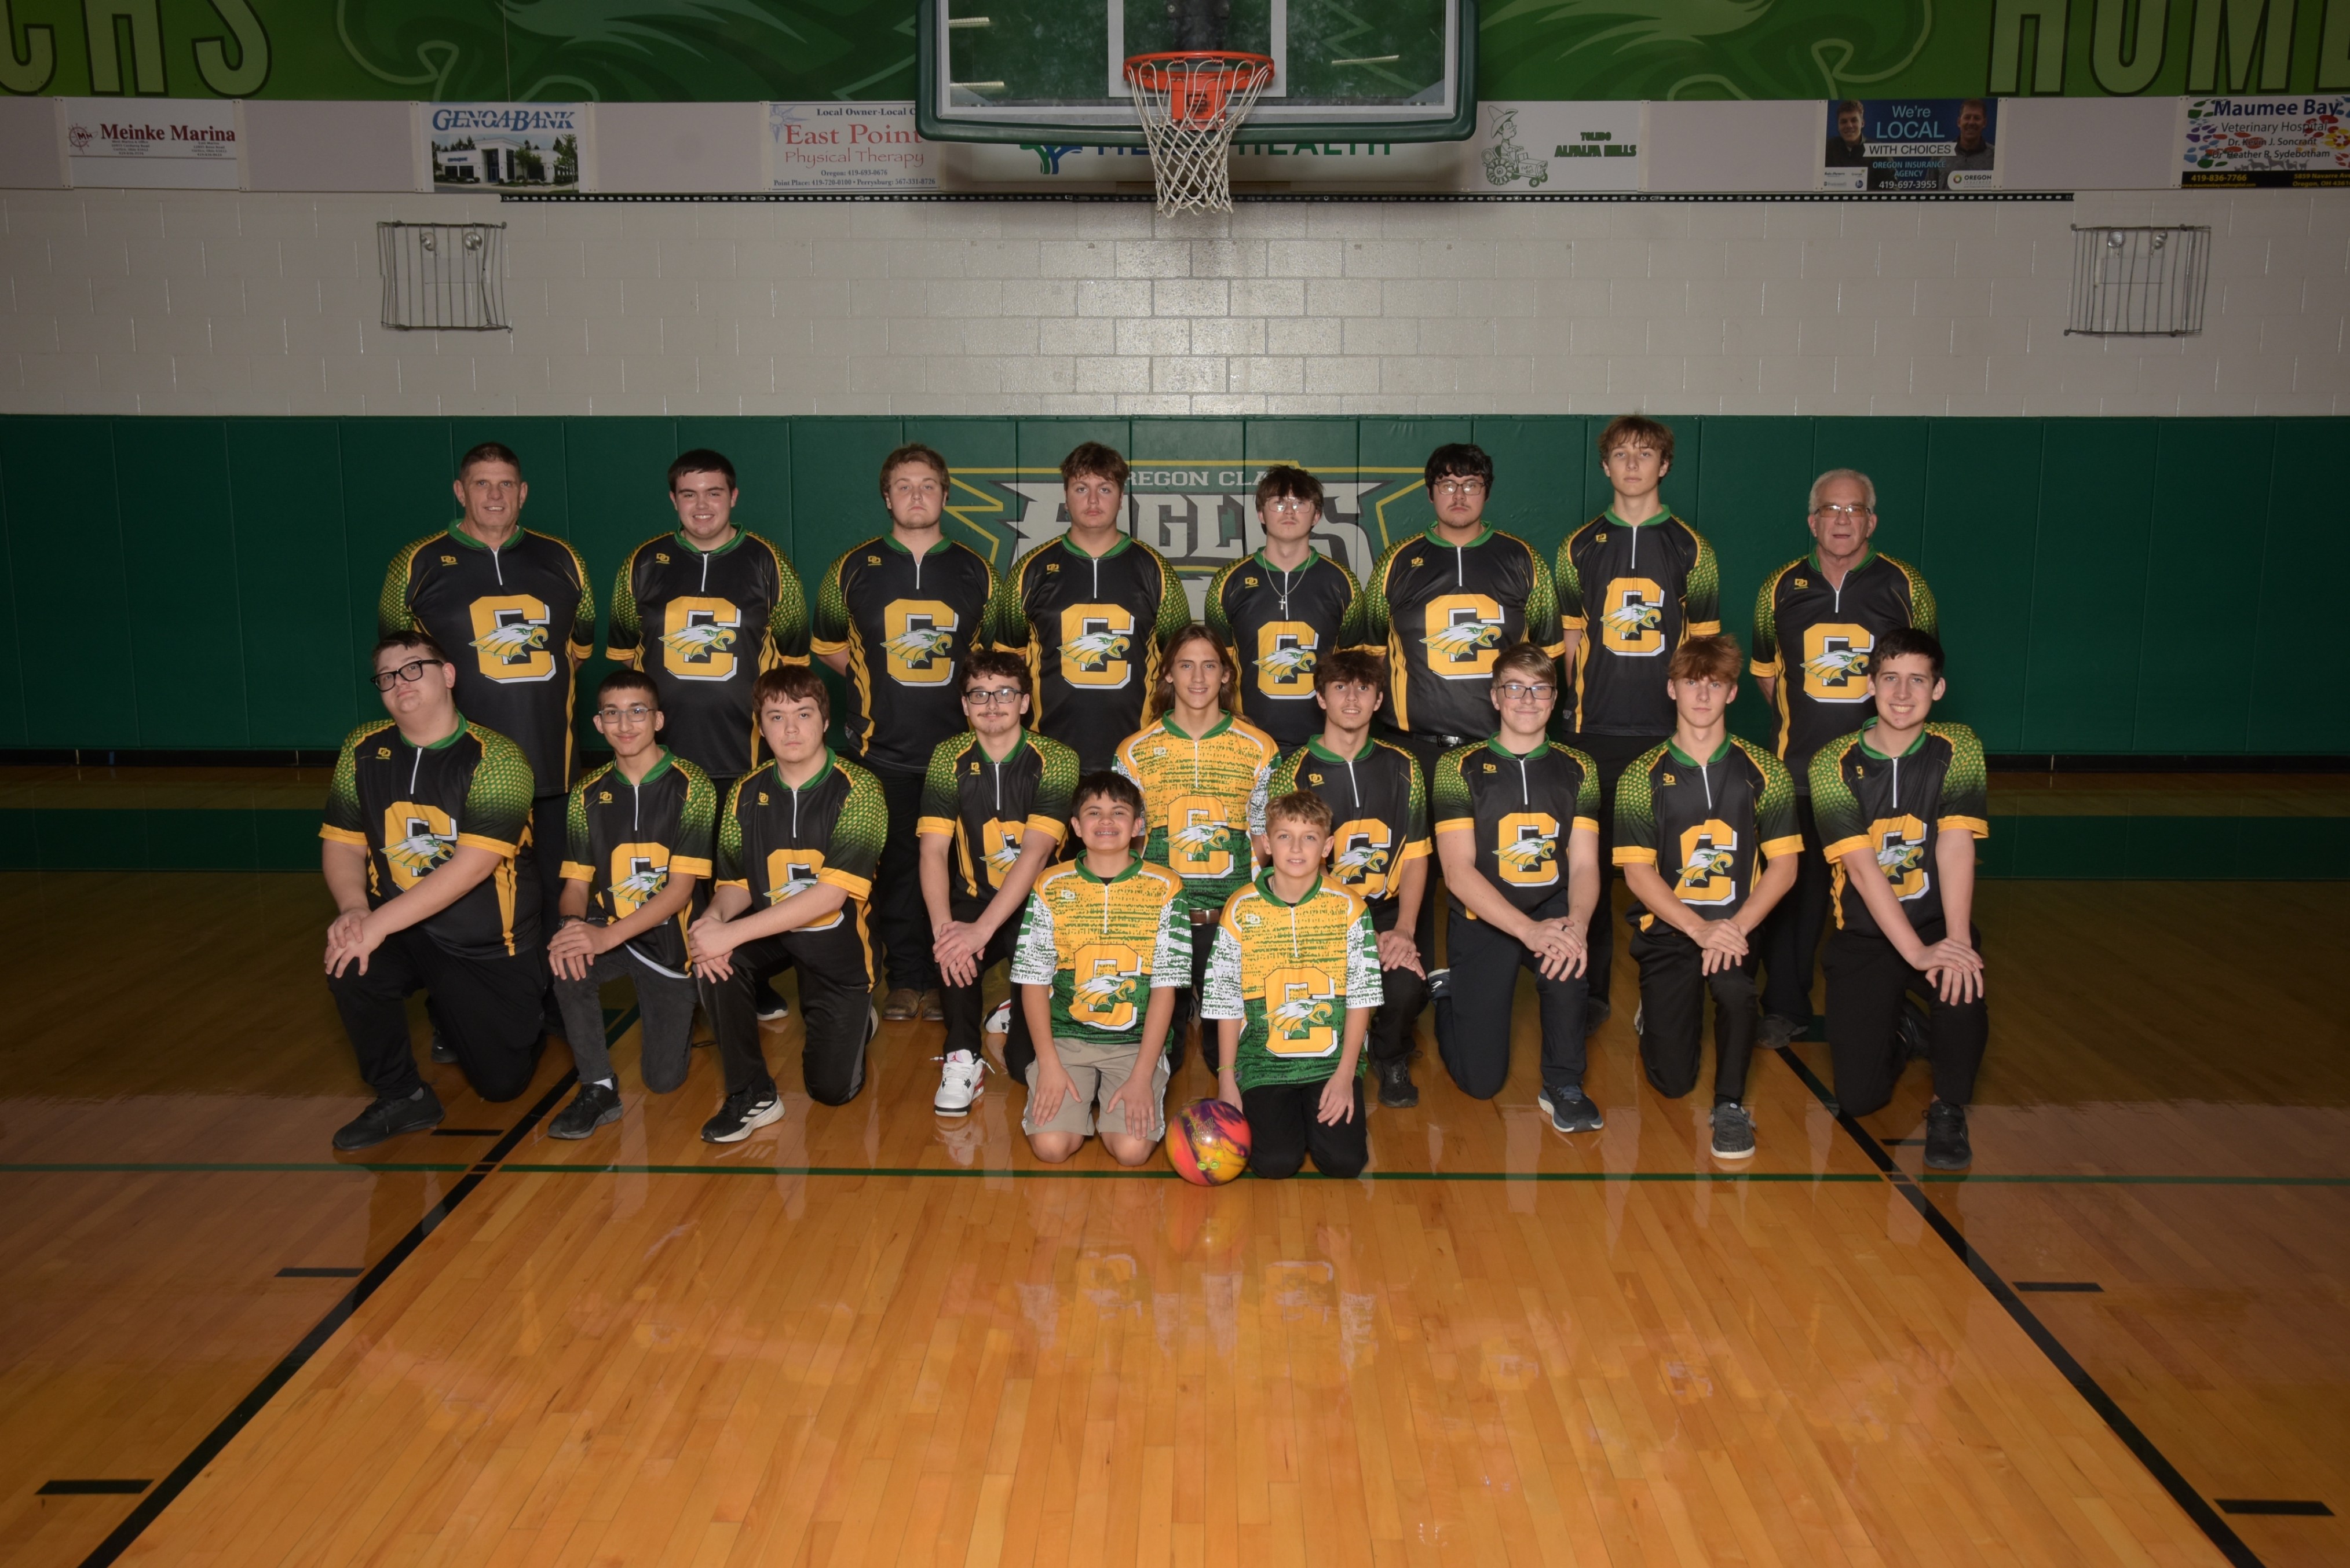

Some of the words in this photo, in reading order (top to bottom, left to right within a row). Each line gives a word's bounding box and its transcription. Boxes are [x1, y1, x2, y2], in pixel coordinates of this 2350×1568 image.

[1892, 105, 1931, 118] We're
[2214, 101, 2298, 116] Maumee
[2304, 99, 2340, 116] Bay
[100, 124, 165, 140] Meinke
[170, 125, 235, 141] Marina
[784, 125, 839, 144] East
[848, 124, 923, 144] Point
[1876, 121, 1945, 139] LOCAL
[2221, 122, 2278, 134] Veterinary
[2282, 121, 2327, 133] Hospital
[1580, 132, 1611, 141] TOLEDO
[1555, 145, 1602, 158] ALFALFA
[1604, 145, 1636, 157] HILLS
[1869, 145, 1897, 155] WITH
[1901, 145, 1951, 154] CHOICES
[785, 147, 850, 168] Physical
[856, 147, 923, 169] Therapy
[1878, 181, 1936, 189] 419-697-3955
[1125, 472, 1208, 486] REGON
